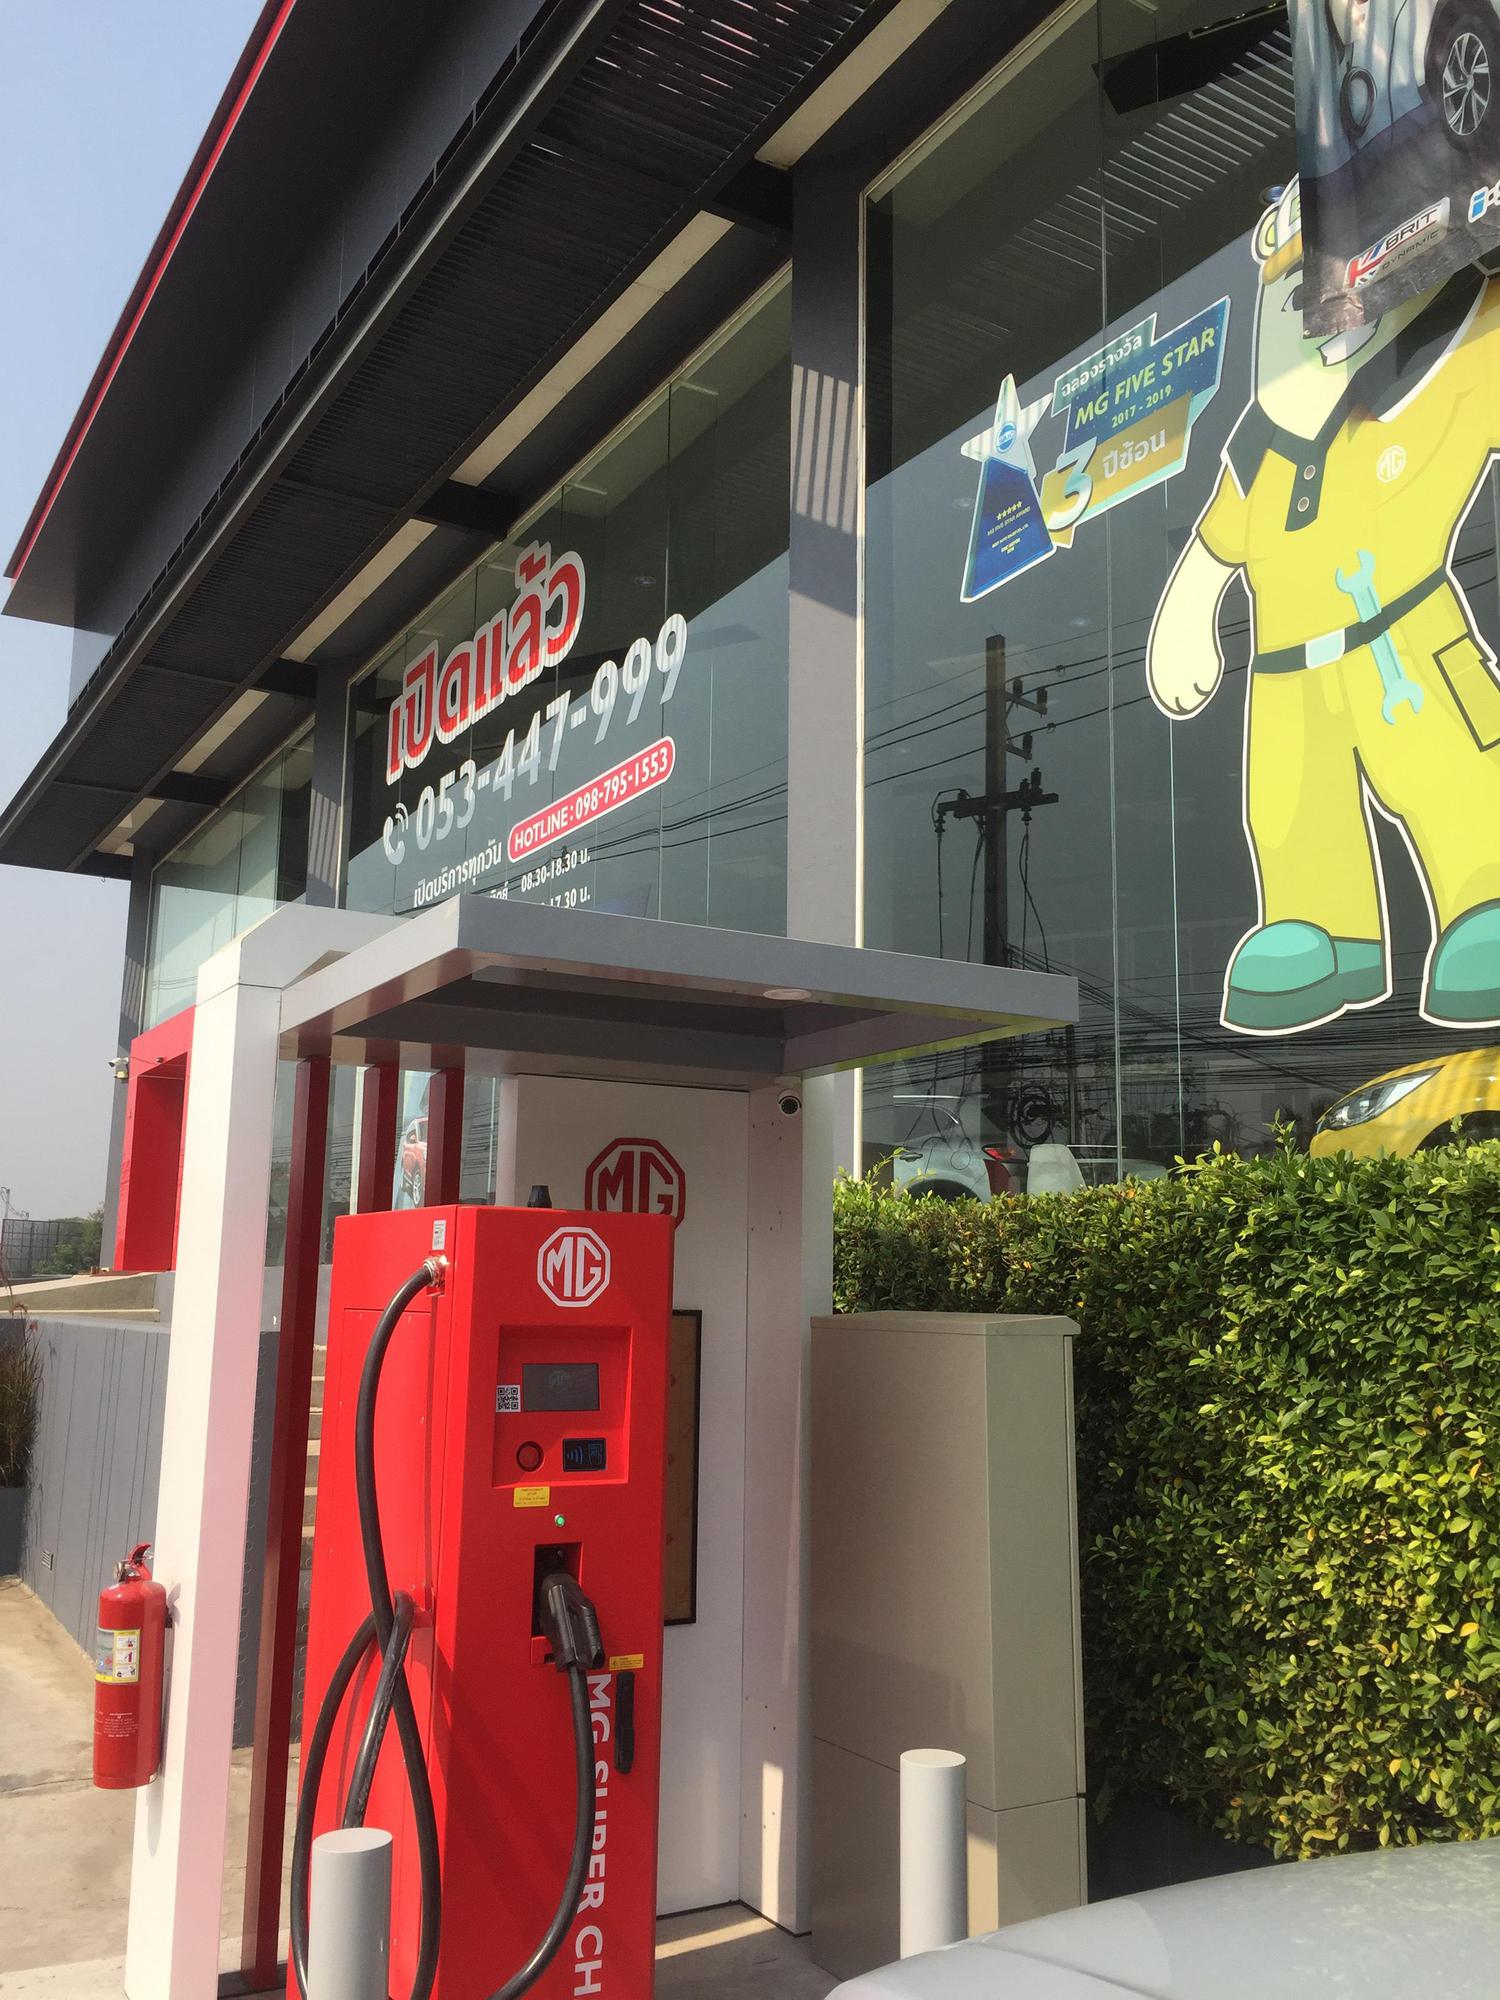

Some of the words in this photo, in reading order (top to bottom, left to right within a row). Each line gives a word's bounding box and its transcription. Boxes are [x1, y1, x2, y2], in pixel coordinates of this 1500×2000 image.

[1385, 208, 1438, 250] BRIT
[1061, 335, 1143, 397] ฉลองรางวัล
[1074, 391, 1110, 430] MG
[1114, 362, 1156, 405] FIVE
[1161, 327, 1216, 377] STAR
[1111, 405, 1137, 429] 2017
[1145, 384, 1172, 408] 2019
[1102, 429, 1166, 479] ปีซ้อน
[1378, 447, 1405, 480] MG
[387, 543, 584, 783] เปิดแล้ว
[415, 613, 688, 850] 053-447-999
[575, 747, 668, 821] 098-795-1553
[413, 838, 503, 908] เปิดบริการทุกวัน
[521, 849, 578, 893] 08.30-18.30
[597, 1146, 677, 1214] MG
[544, 1234, 603, 1299] MG
[586, 1673, 612, 1744] MG
